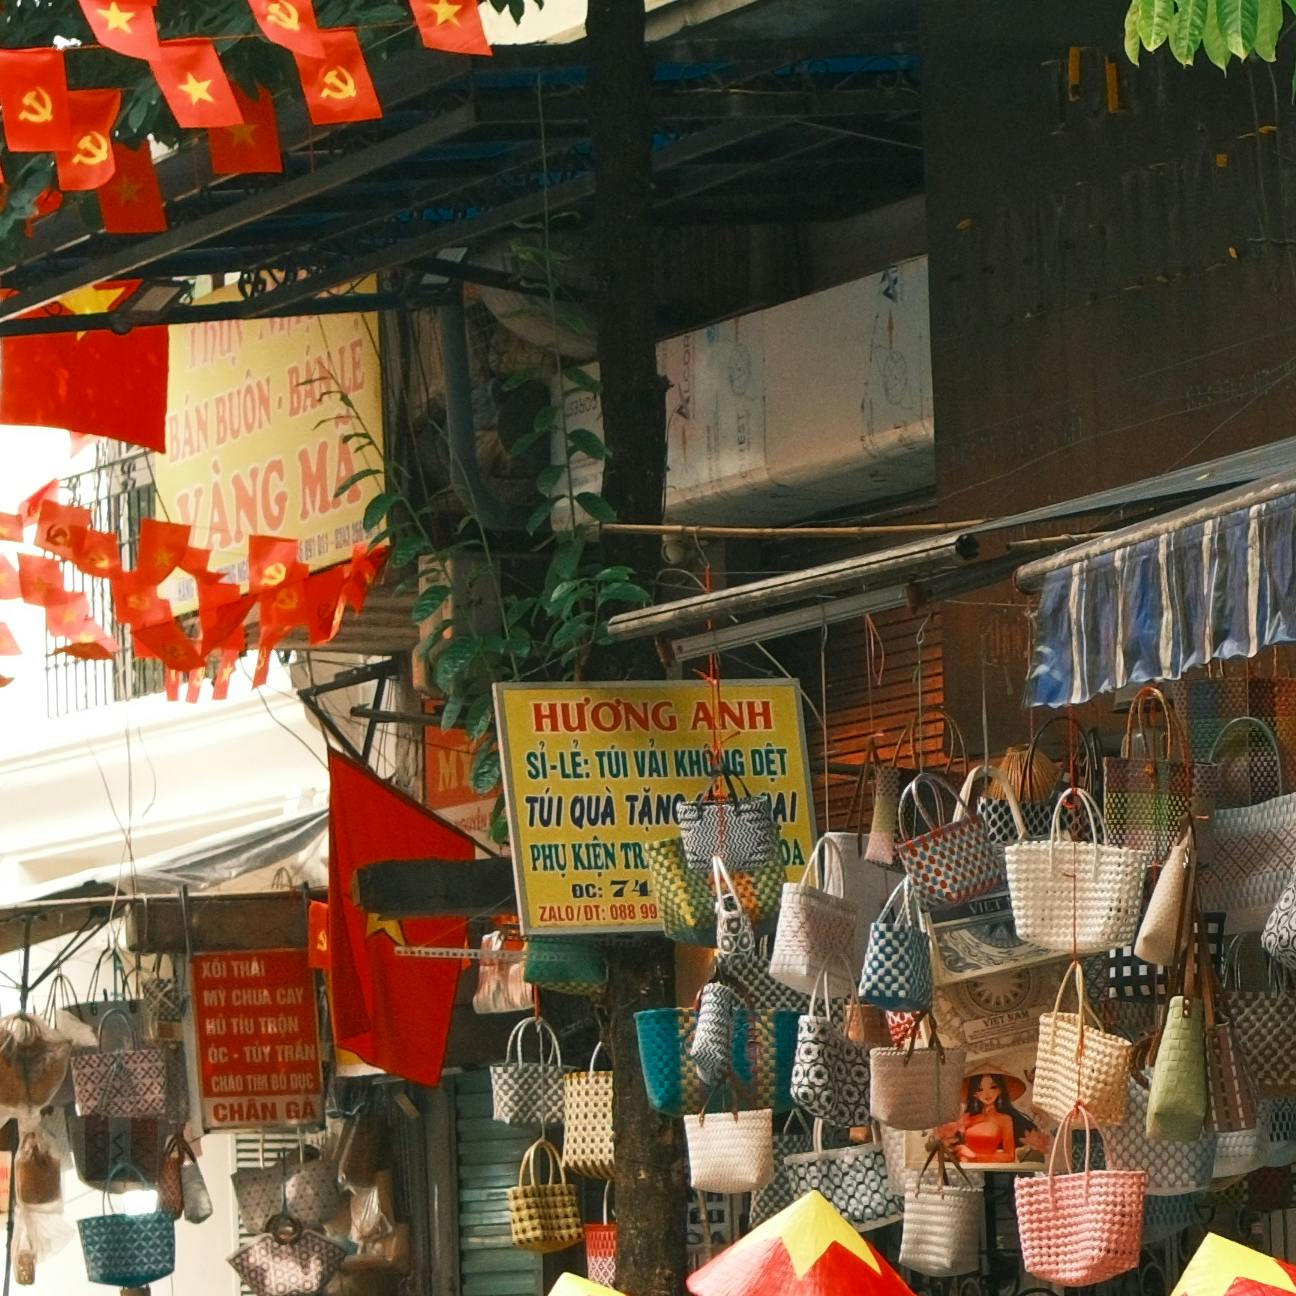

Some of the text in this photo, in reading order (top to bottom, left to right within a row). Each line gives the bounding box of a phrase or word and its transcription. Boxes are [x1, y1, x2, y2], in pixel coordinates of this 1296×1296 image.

[177, 411, 362, 549] VÀNG MÃ
[532, 697, 774, 733] HƯƠNG ANH
[597, 745, 629, 779] TÚI
[635, 738, 667, 778] VẢI
[751, 742, 787, 783] DỆT
[526, 787, 562, 828] TÚI
[571, 787, 615, 829] QUÀ
[530, 843, 567, 878] PHỤ
[572, 835, 616, 878] KIỆN
[610, 903, 636, 920] 088
